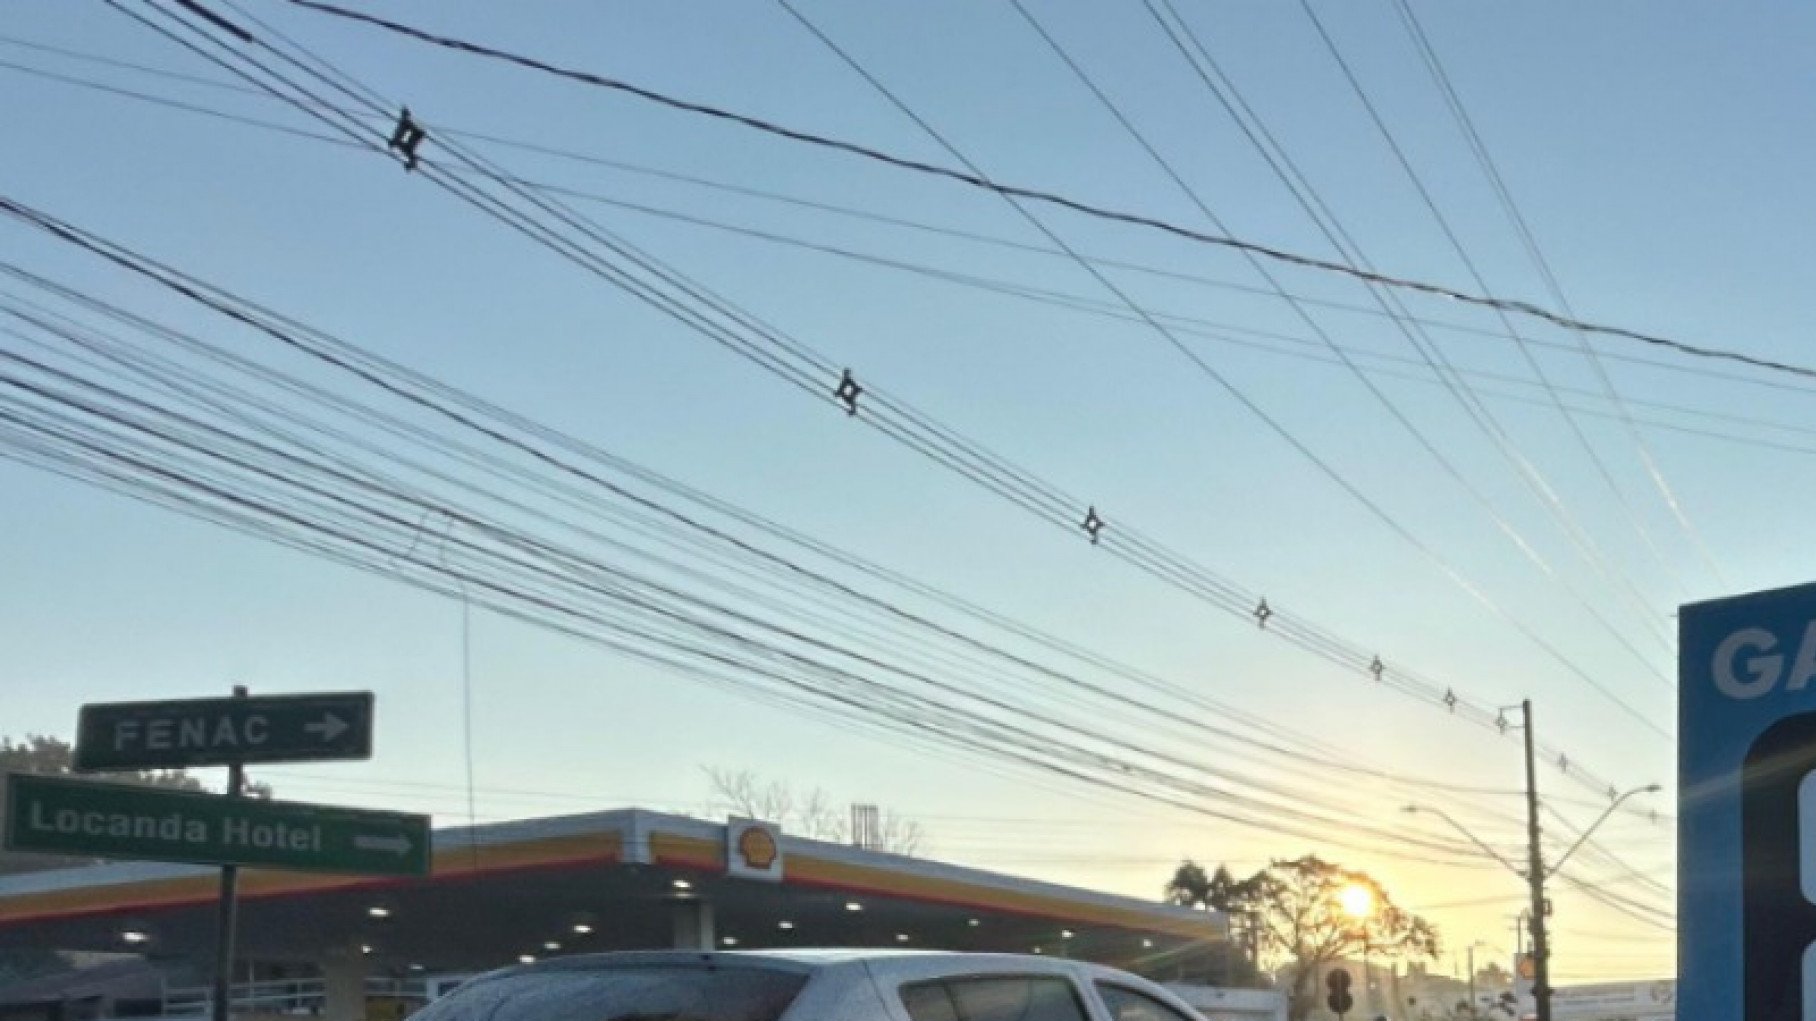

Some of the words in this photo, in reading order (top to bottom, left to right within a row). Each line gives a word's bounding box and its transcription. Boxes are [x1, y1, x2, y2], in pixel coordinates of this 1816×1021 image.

[113, 715, 270, 752] FENAC
[30, 800, 208, 844] Locanda
[222, 815, 323, 853] Hotel
